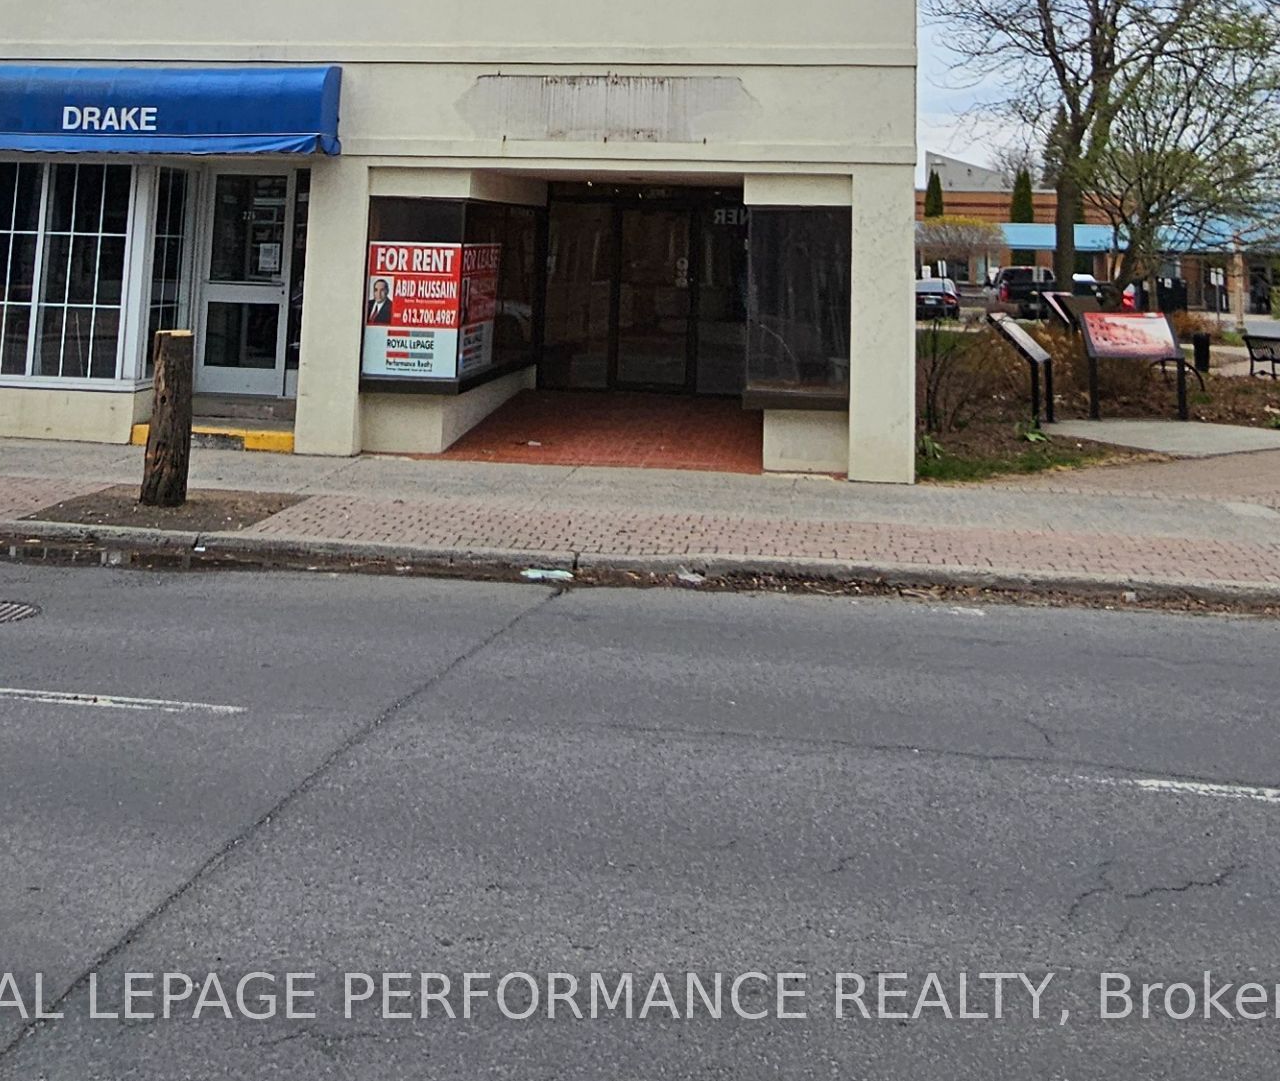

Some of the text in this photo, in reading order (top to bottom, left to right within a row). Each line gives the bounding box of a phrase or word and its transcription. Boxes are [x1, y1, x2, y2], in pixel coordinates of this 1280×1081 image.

[62, 106, 158, 131] DRAKE
[376, 248, 455, 272] FOR RENT
[395, 279, 416, 298] ABID
[418, 280, 457, 299] HUSSAIN
[402, 309, 456, 325] 613.700.4987
[387, 339, 408, 349] ROYAL
